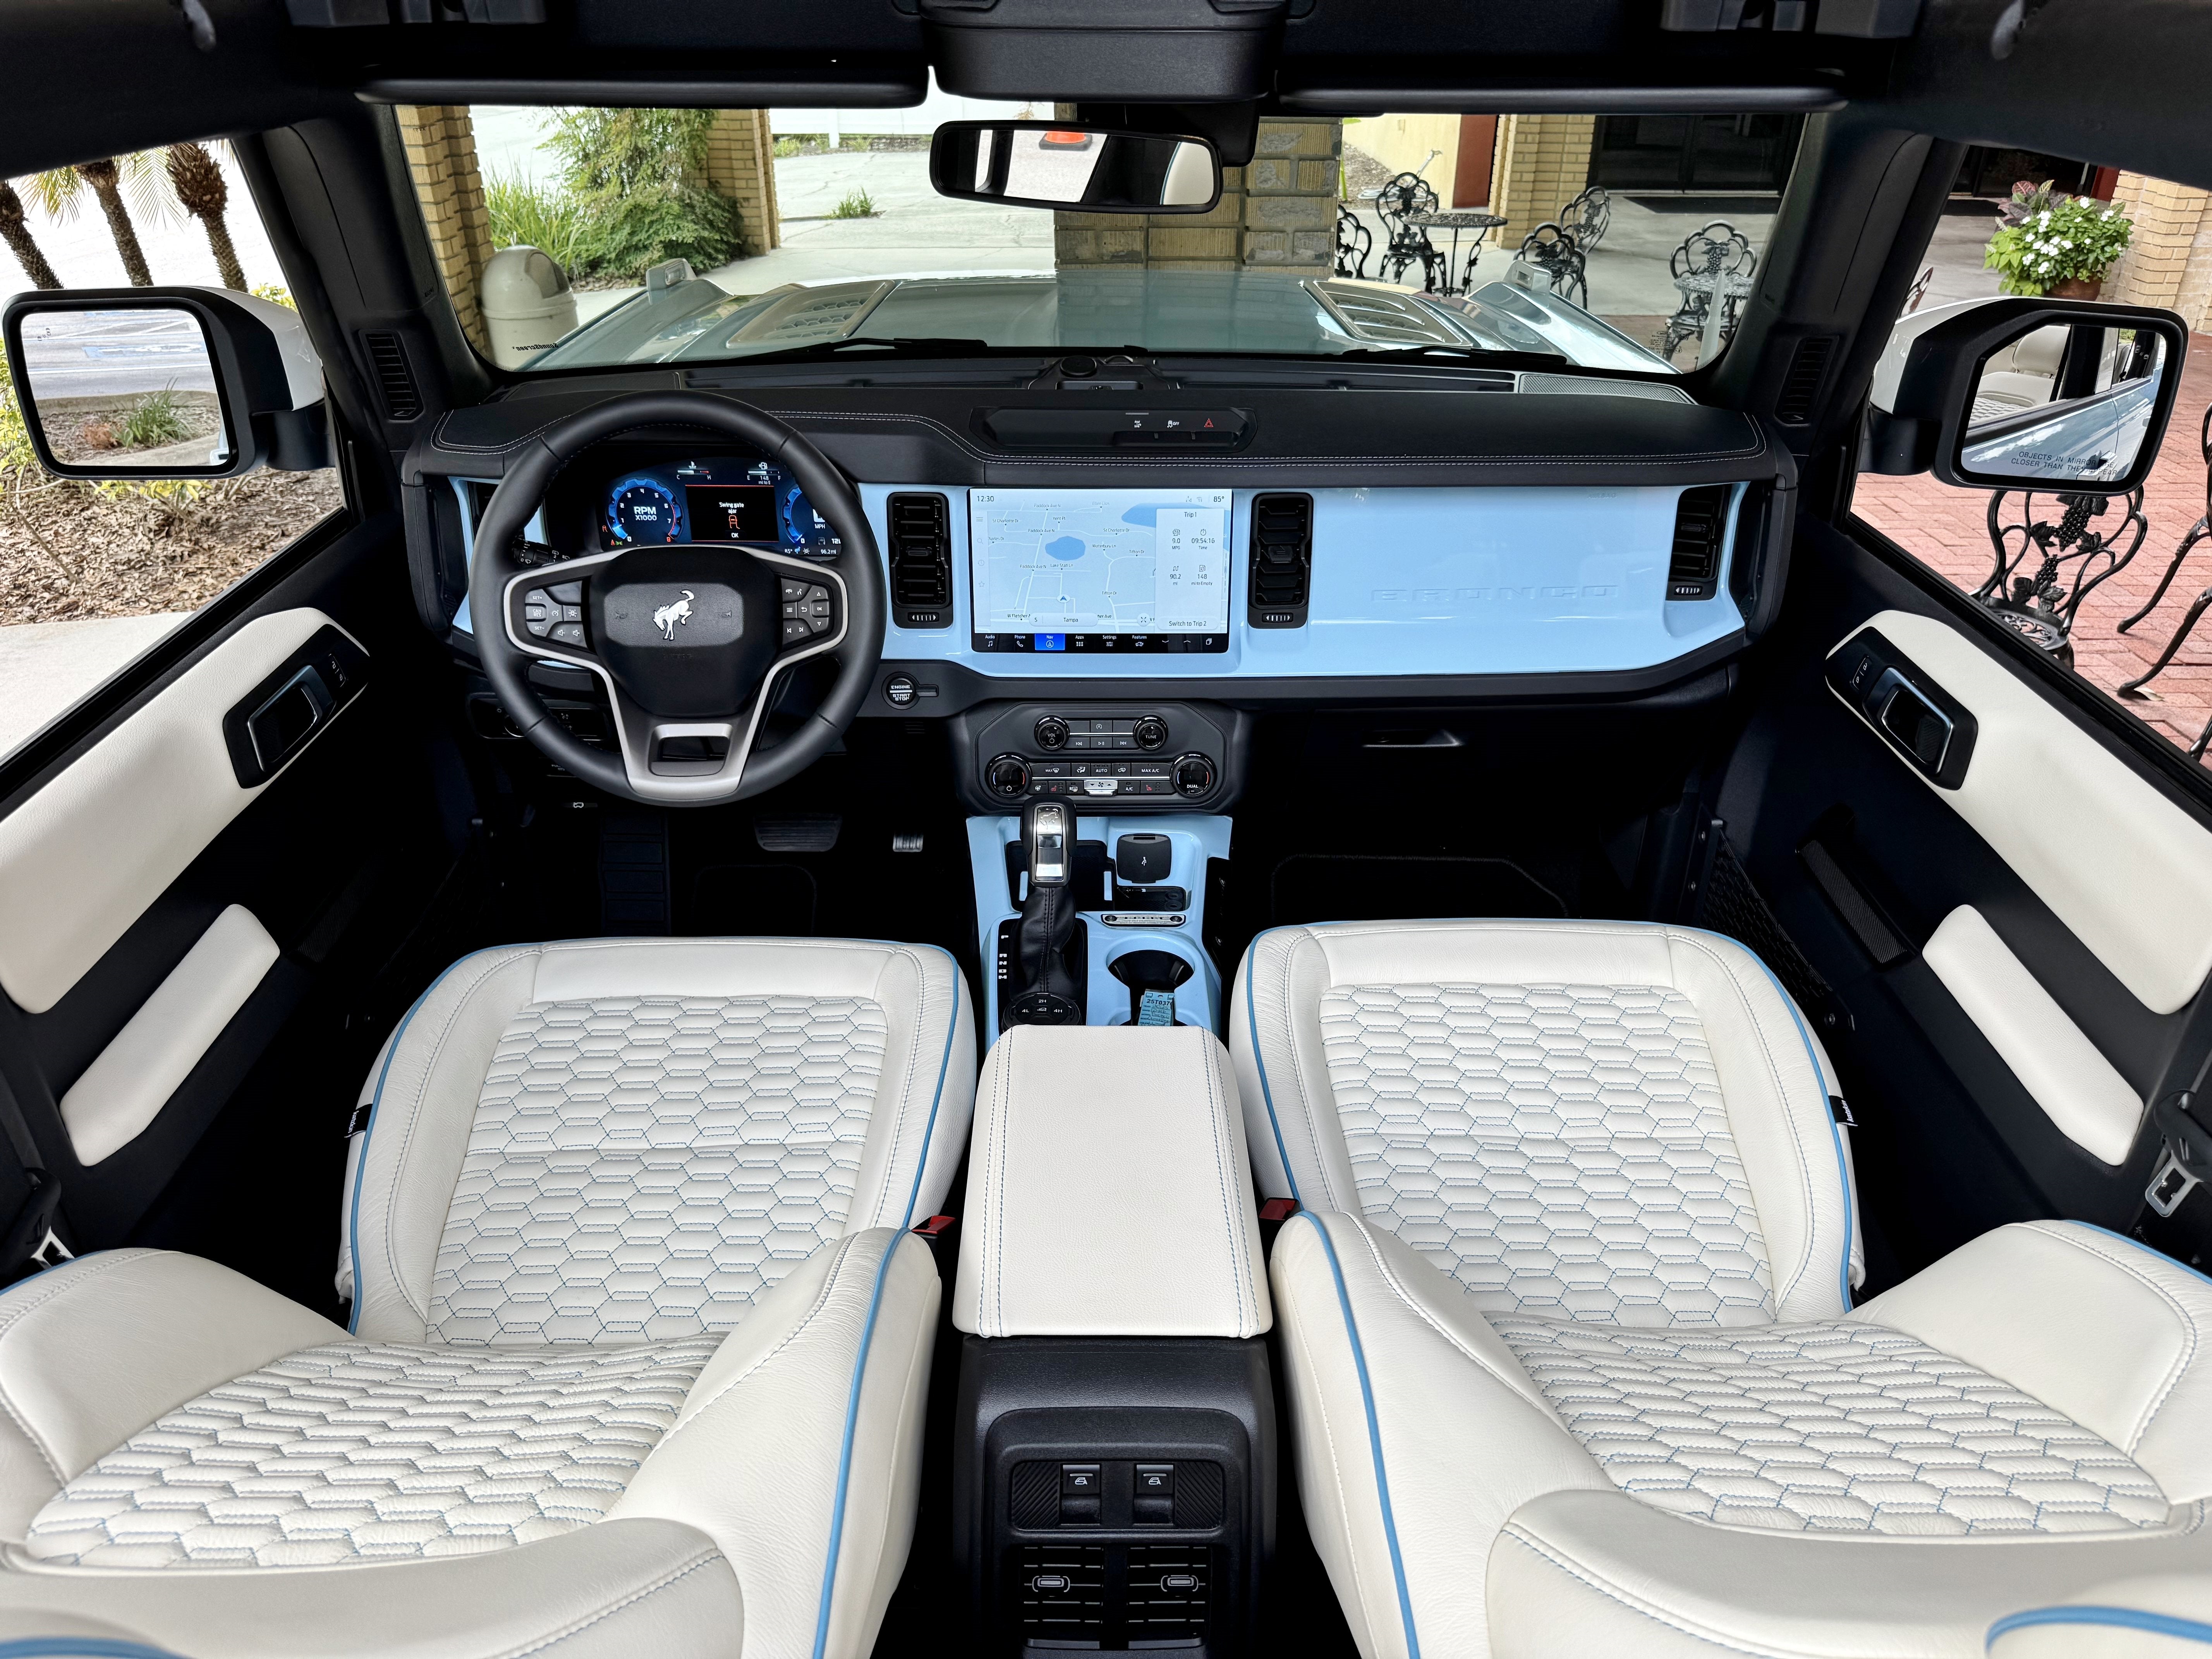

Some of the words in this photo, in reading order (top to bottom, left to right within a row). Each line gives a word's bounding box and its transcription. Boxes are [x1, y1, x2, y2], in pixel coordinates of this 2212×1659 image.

[2019, 452, 2052, 461] OBJECTS
[2011, 458, 2040, 467] CLOSER
[634, 506, 656, 515] RPM
[1371, 585, 1618, 602] BRONCO
